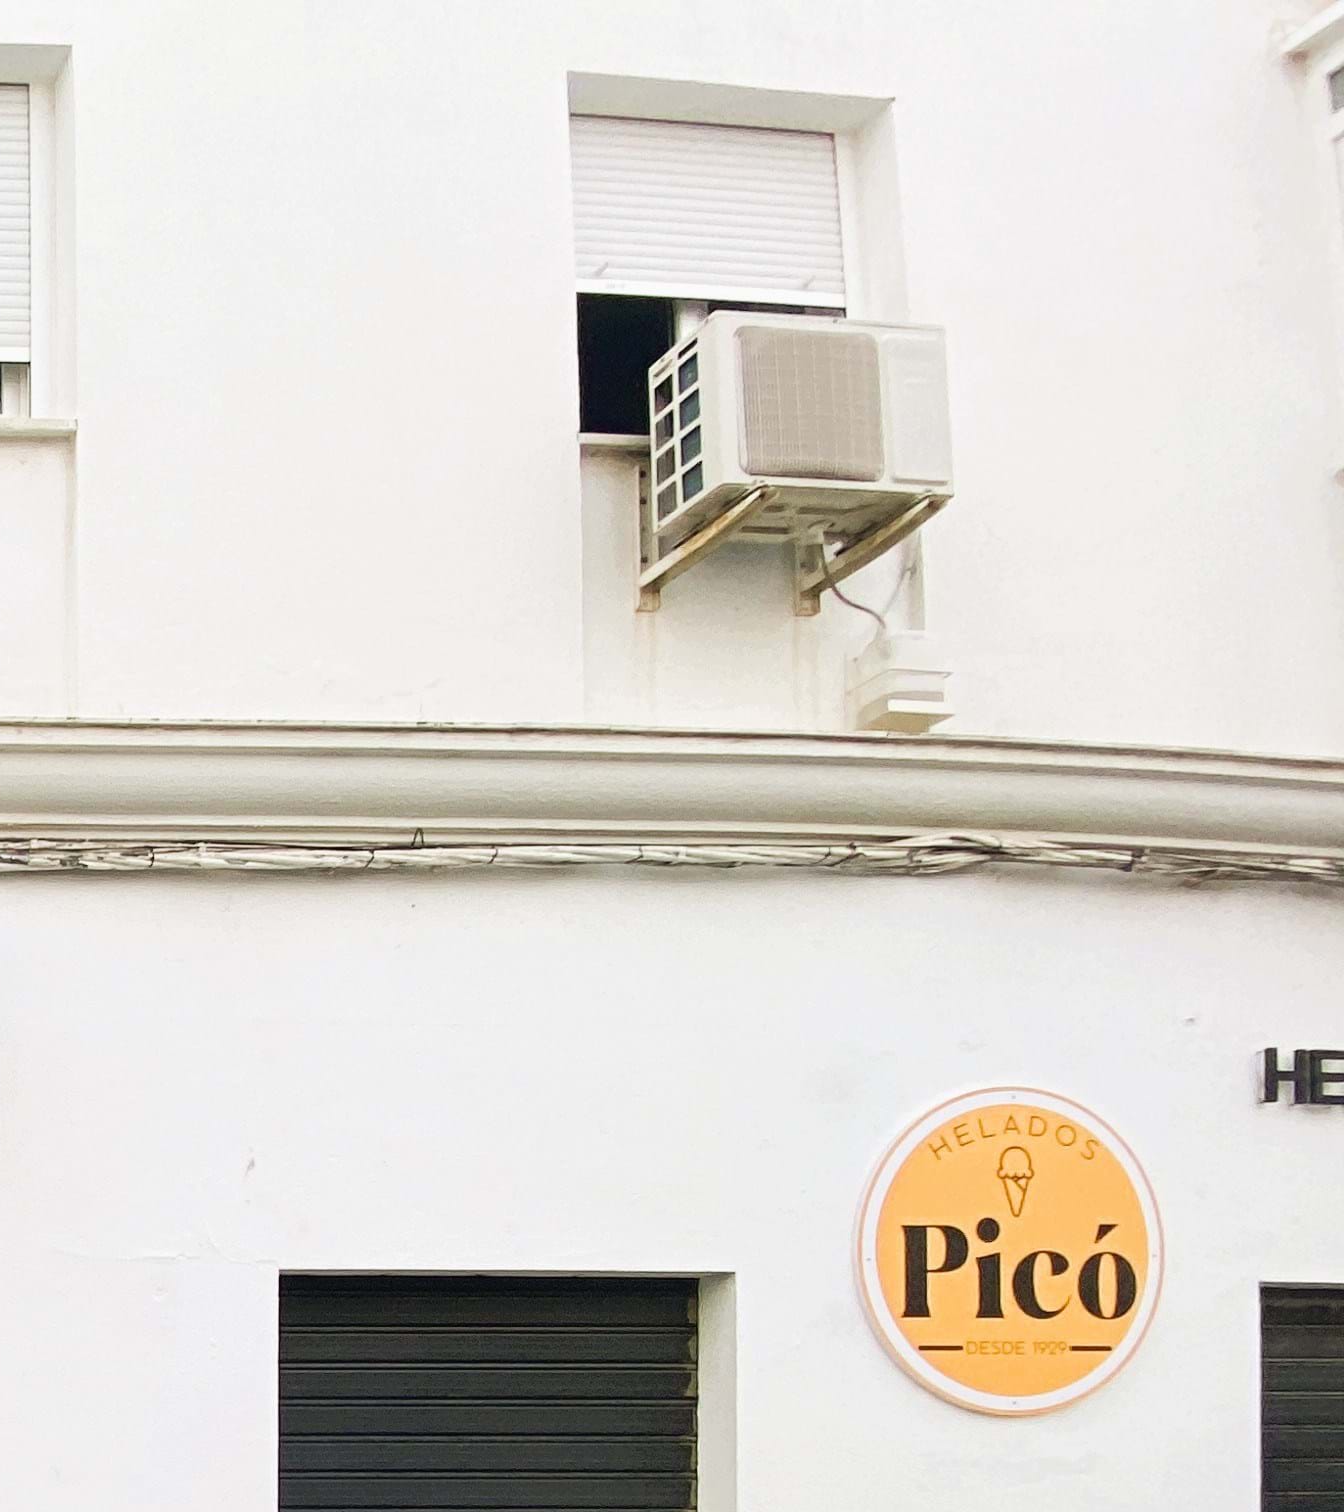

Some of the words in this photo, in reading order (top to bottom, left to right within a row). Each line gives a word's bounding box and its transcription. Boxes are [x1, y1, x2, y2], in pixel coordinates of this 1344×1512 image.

[928, 1115, 1100, 1160] HELADOS
[902, 1217, 1137, 1320] Picó
[965, 1340, 1025, 1355] DESDE
